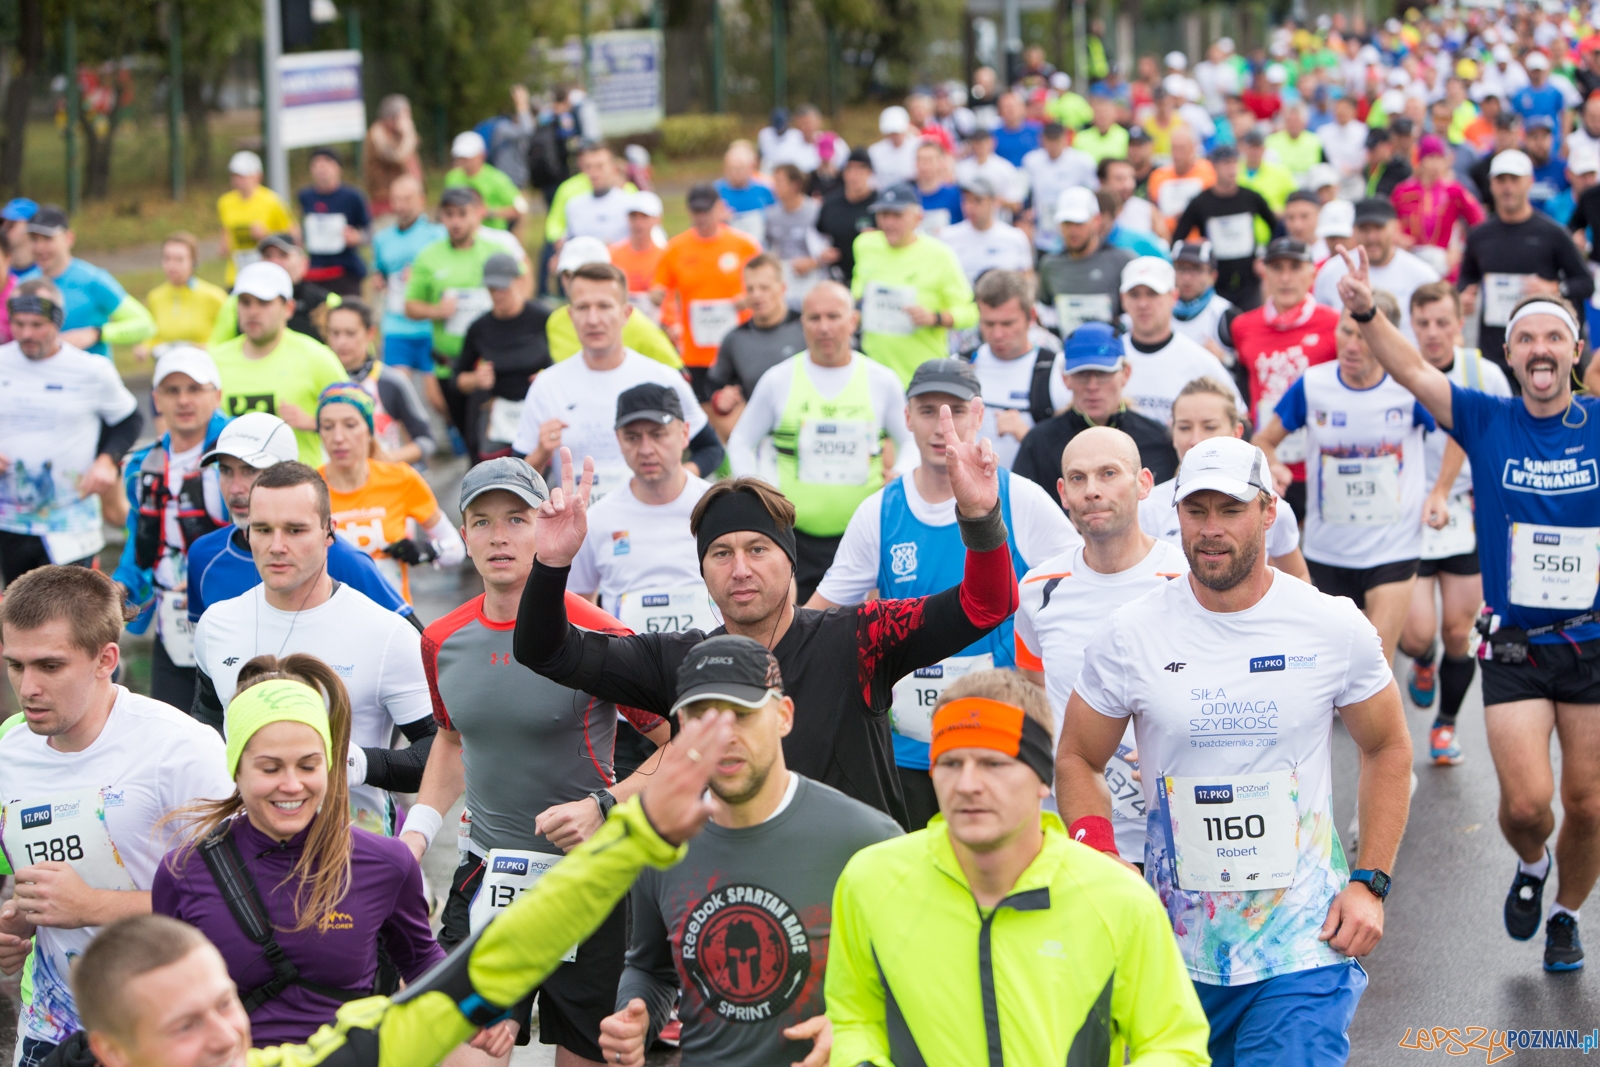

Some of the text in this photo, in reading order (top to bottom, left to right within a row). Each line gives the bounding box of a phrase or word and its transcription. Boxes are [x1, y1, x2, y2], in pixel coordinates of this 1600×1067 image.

[1512, 468, 1591, 490] WYZWANIE
[1346, 482, 1376, 497] 153
[1533, 554, 1581, 572] 5561
[646, 615, 693, 633] 6712
[222, 657, 240, 667] 4F
[707, 657, 734, 666] asics
[1164, 661, 1187, 673] 4F
[915, 689, 945, 706] 18
[1191, 687, 1227, 701] SIŁA
[1201, 701, 1279, 716] ODWAGA
[1190, 715, 1279, 732] SZYBKOŚĆ
[1191, 739, 1277, 749] 9 października 2016
[1236, 790, 1270, 799] maraton
[1203, 814, 1266, 841] 1160
[25, 834, 84, 866] 1388
[1217, 846, 1258, 859] Robert
[1246, 872, 1260, 881] 4F
[490, 885, 531, 908] 13
[683, 887, 809, 960] Reebok SPARTAN RACE
[718, 1000, 772, 1021] SPRINT
